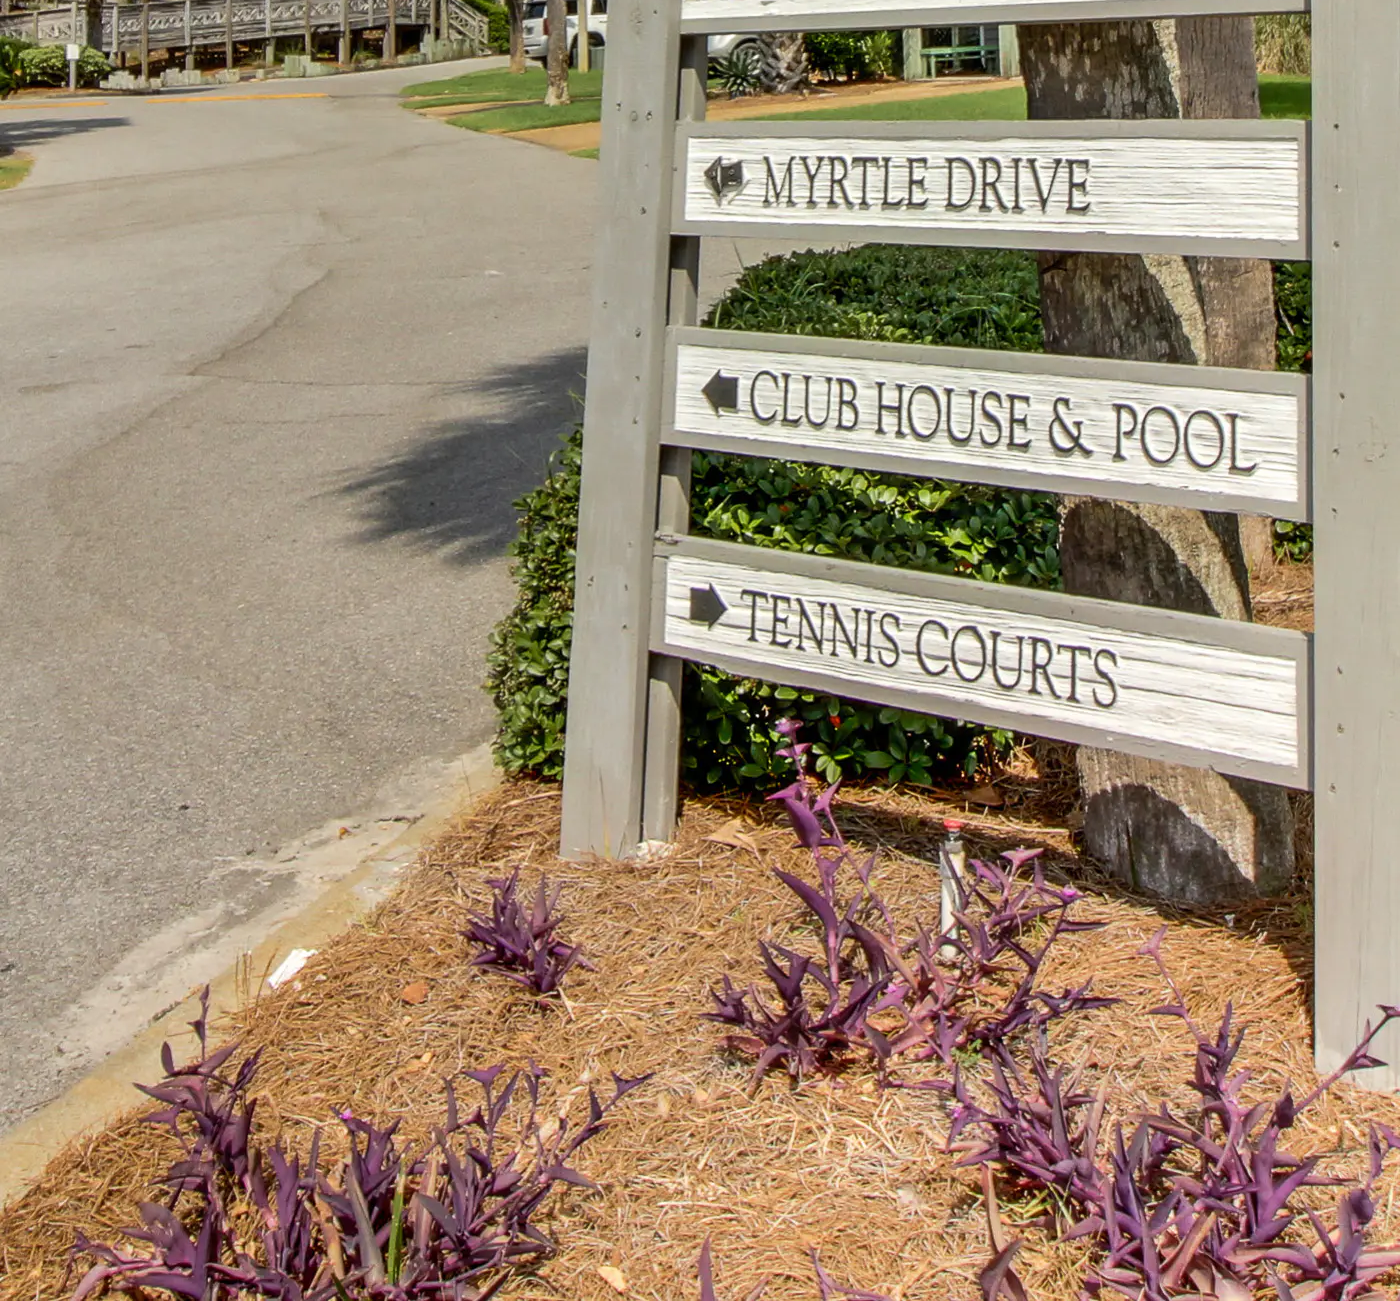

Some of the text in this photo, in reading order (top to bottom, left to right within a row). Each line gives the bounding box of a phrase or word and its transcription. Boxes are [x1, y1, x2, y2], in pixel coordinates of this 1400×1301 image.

[763, 155, 1092, 215] MYRTLE DRIVE
[749, 370, 1258, 474] CLUB HOUSE & POOL
[740, 589, 1119, 708] TENNIS COURTS
